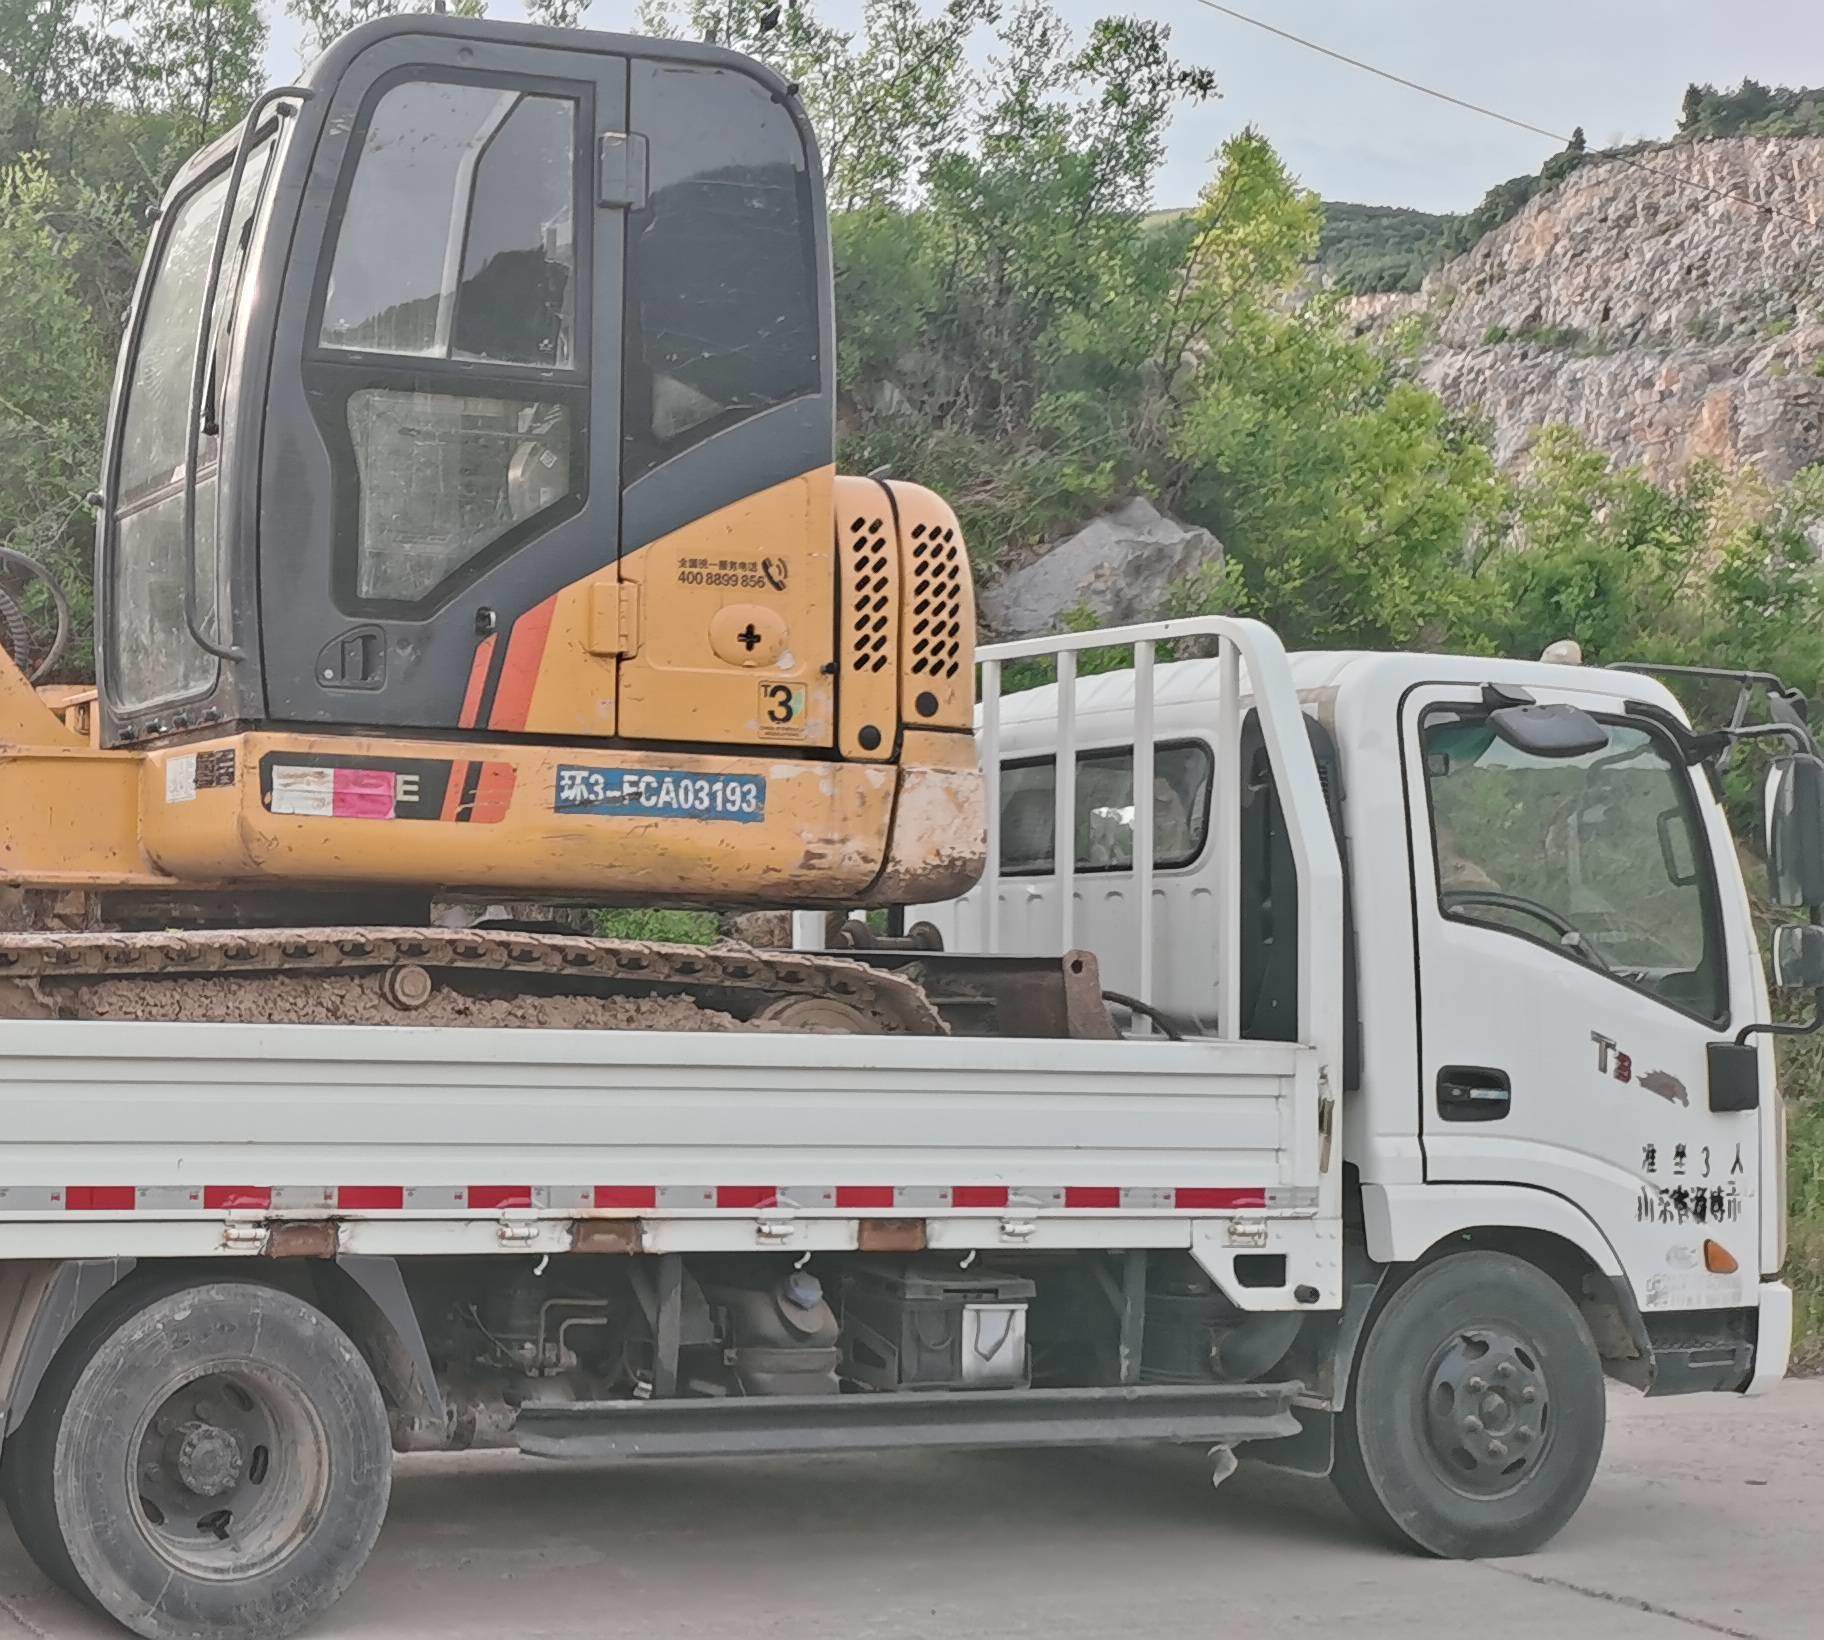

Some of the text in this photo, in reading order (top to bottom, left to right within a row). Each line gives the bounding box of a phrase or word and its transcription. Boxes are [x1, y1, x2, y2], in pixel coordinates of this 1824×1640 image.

[678, 570, 766, 588] 400 8899 856
[560, 770, 757, 813] 环3-FCA03193
